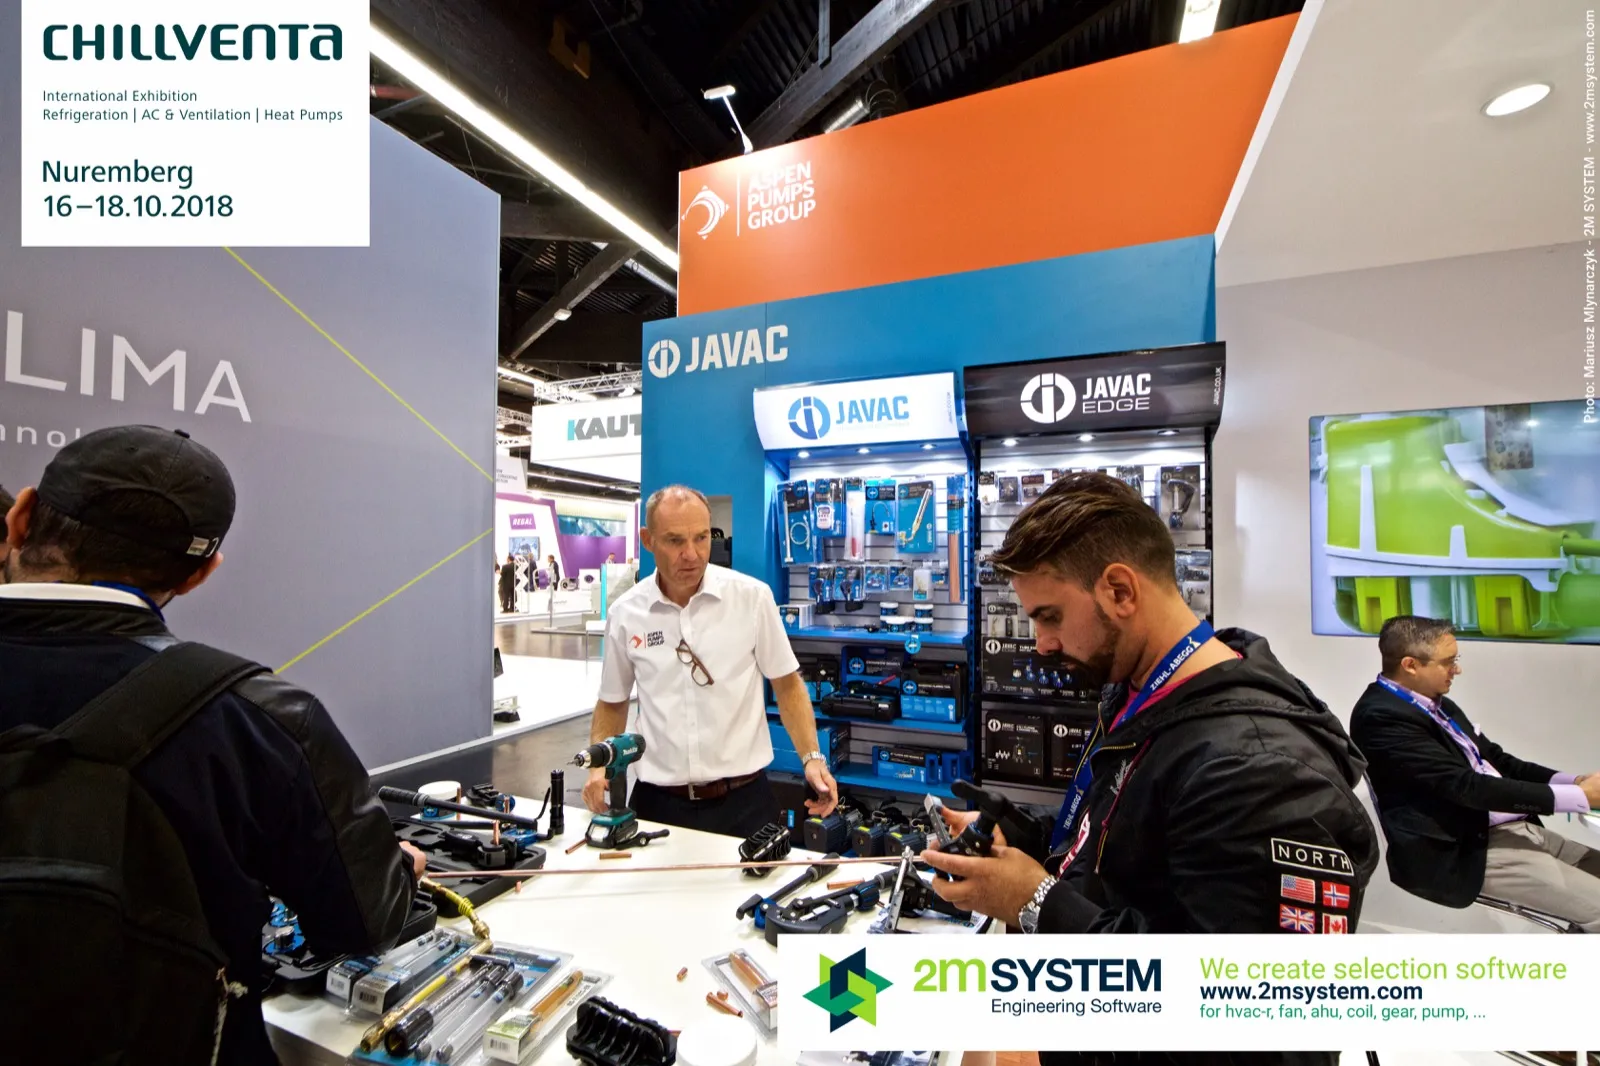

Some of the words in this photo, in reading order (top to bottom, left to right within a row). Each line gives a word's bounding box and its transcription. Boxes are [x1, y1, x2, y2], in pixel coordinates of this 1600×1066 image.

[748, 161, 811, 193] ASPEN
[748, 179, 814, 212] PUMPS
[748, 199, 816, 229] GROUP
[686, 325, 788, 373] JAVAC
[5, 310, 252, 423] LIMA
[1082, 373, 1151, 399] JAVAC
[836, 395, 909, 424] JAVAC
[1082, 397, 1150, 414] EDGE
[568, 413, 642, 440] KAUT
[1150, 645, 1194, 691] ZIEHL-ABEGG
[1278, 844, 1350, 870] NORTH
